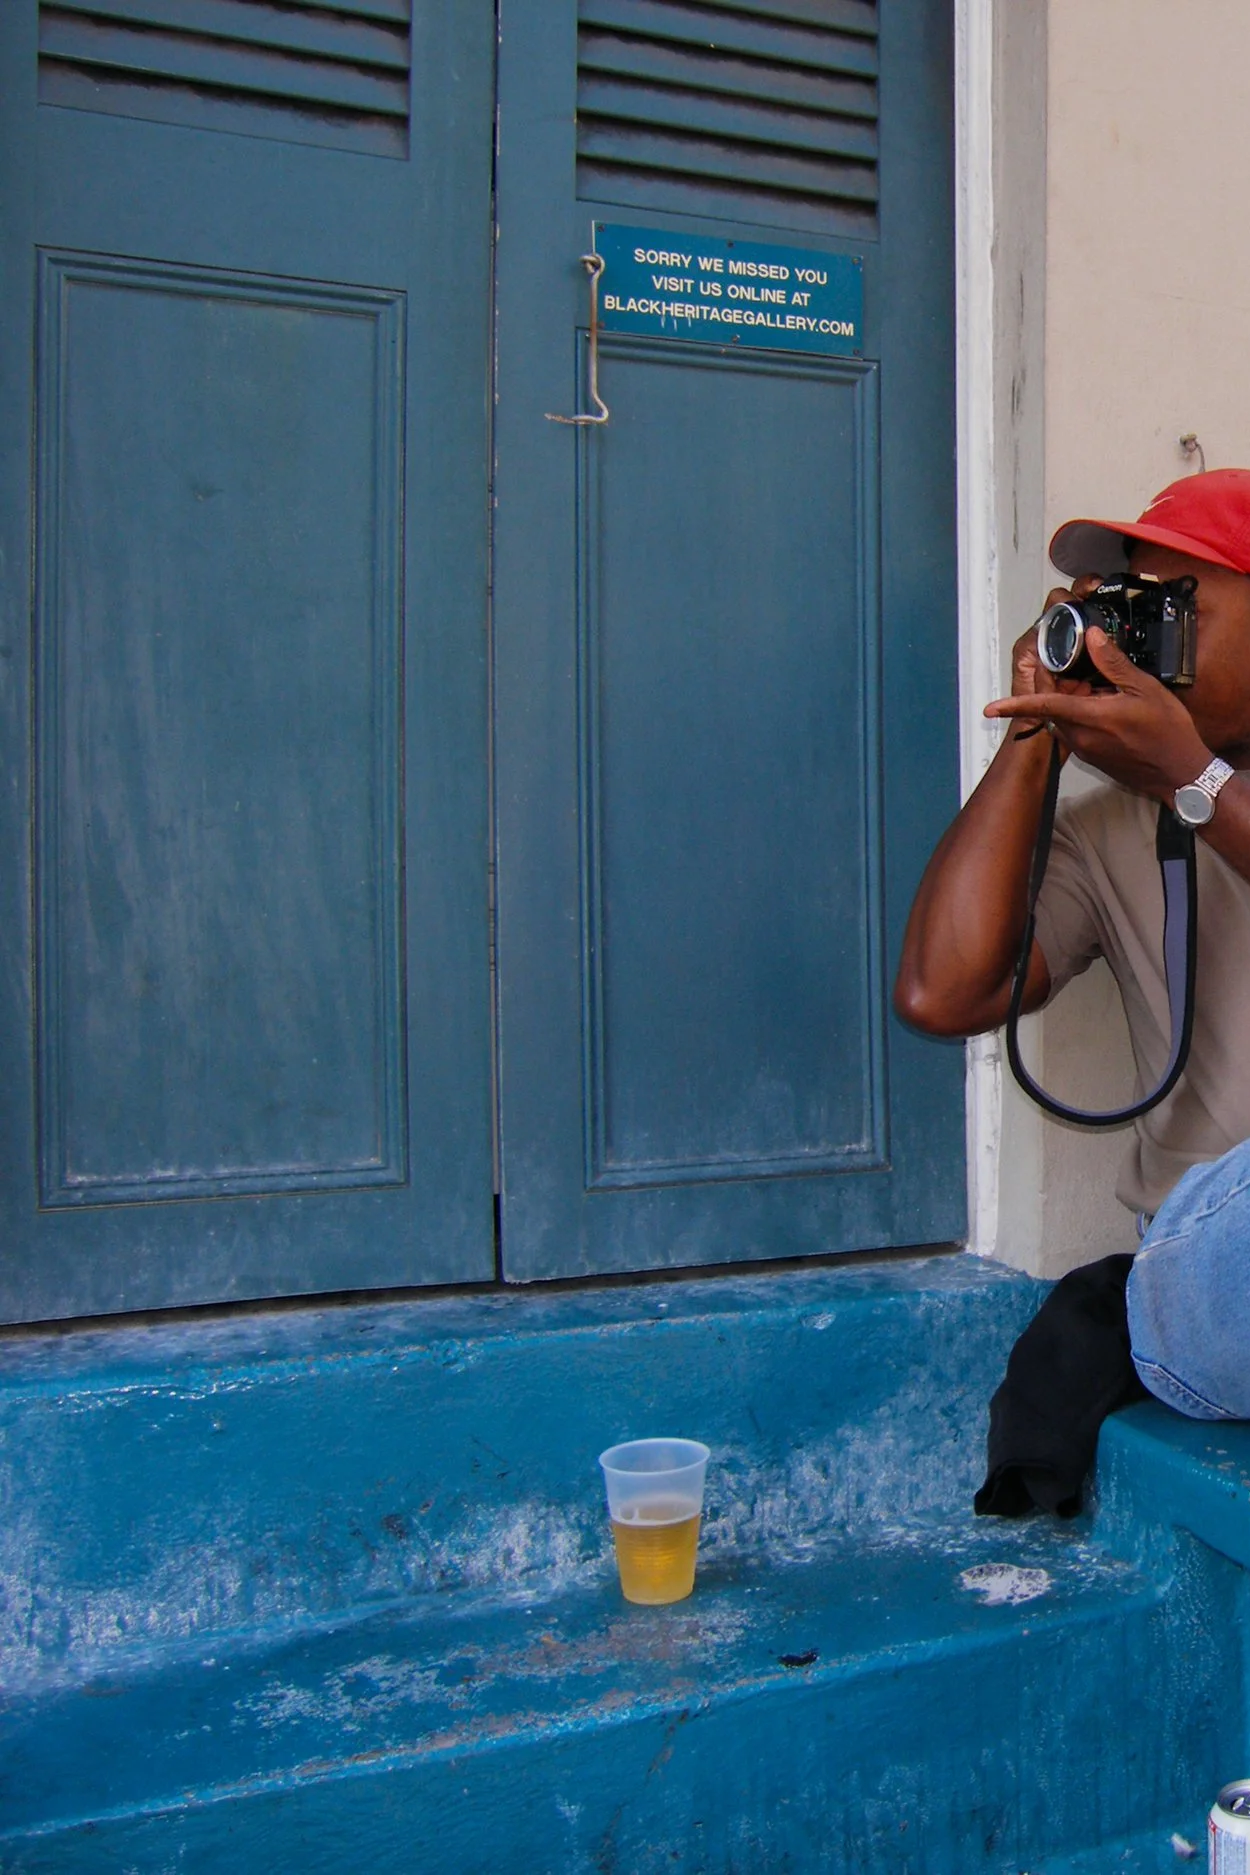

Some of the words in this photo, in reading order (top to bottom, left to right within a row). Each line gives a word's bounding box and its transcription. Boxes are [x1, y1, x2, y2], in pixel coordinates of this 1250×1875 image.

[634, 248, 692, 269] SORRY
[697, 256, 724, 273] WE
[728, 260, 790, 280] MISSED
[794, 268, 828, 285] YOU
[652, 275, 695, 293] VISIT
[700, 281, 722, 297] US
[727, 284, 786, 305] ONLINE
[791, 292, 811, 306] AT
[604, 295, 854, 336] BLACKHERITAGEGALLERY.COM
[1097, 584, 1123, 594] Canon
